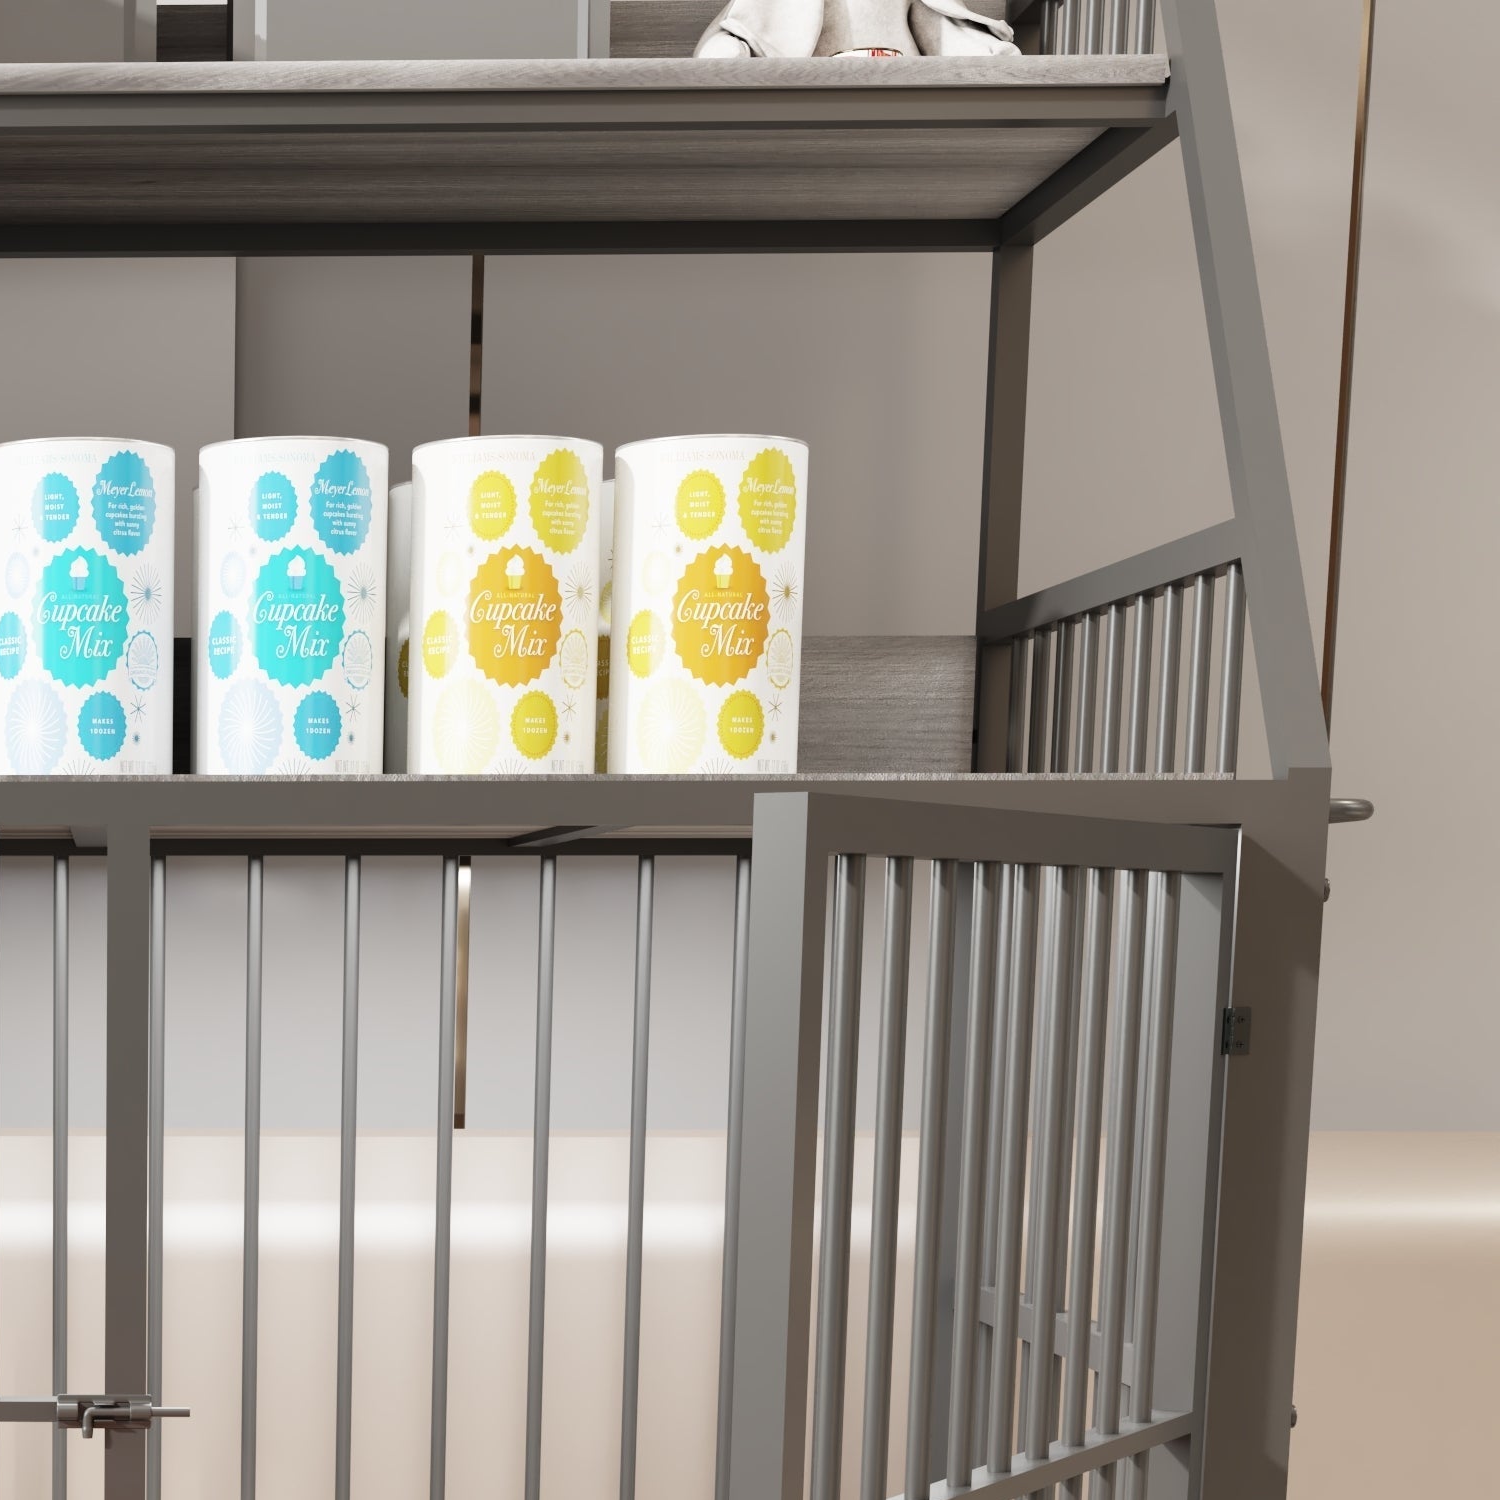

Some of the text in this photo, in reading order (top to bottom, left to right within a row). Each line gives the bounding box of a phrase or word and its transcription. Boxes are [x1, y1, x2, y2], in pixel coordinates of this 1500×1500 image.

[44, 493, 64, 501] LIGHT,
[261, 492, 282, 500] LIGHT,
[689, 490, 710, 498] LIGHT,
[45, 503, 64, 511] MOIST
[262, 502, 282, 510] MOIST
[480, 501, 501, 509] MOIST
[45, 513, 70, 521] TENDER
[263, 512, 288, 520] TENDER
[482, 511, 507, 519] TENDER
[36, 591, 122, 631] Cupcake
[253, 590, 339, 631] Cupcake
[469, 590, 557, 630] Cupcake
[677, 589, 764, 629] Cupcake
[59, 625, 114, 660] Mix
[275, 625, 330, 659] Mix
[493, 624, 547, 658] Mix
[700, 623, 754, 658] Mix
